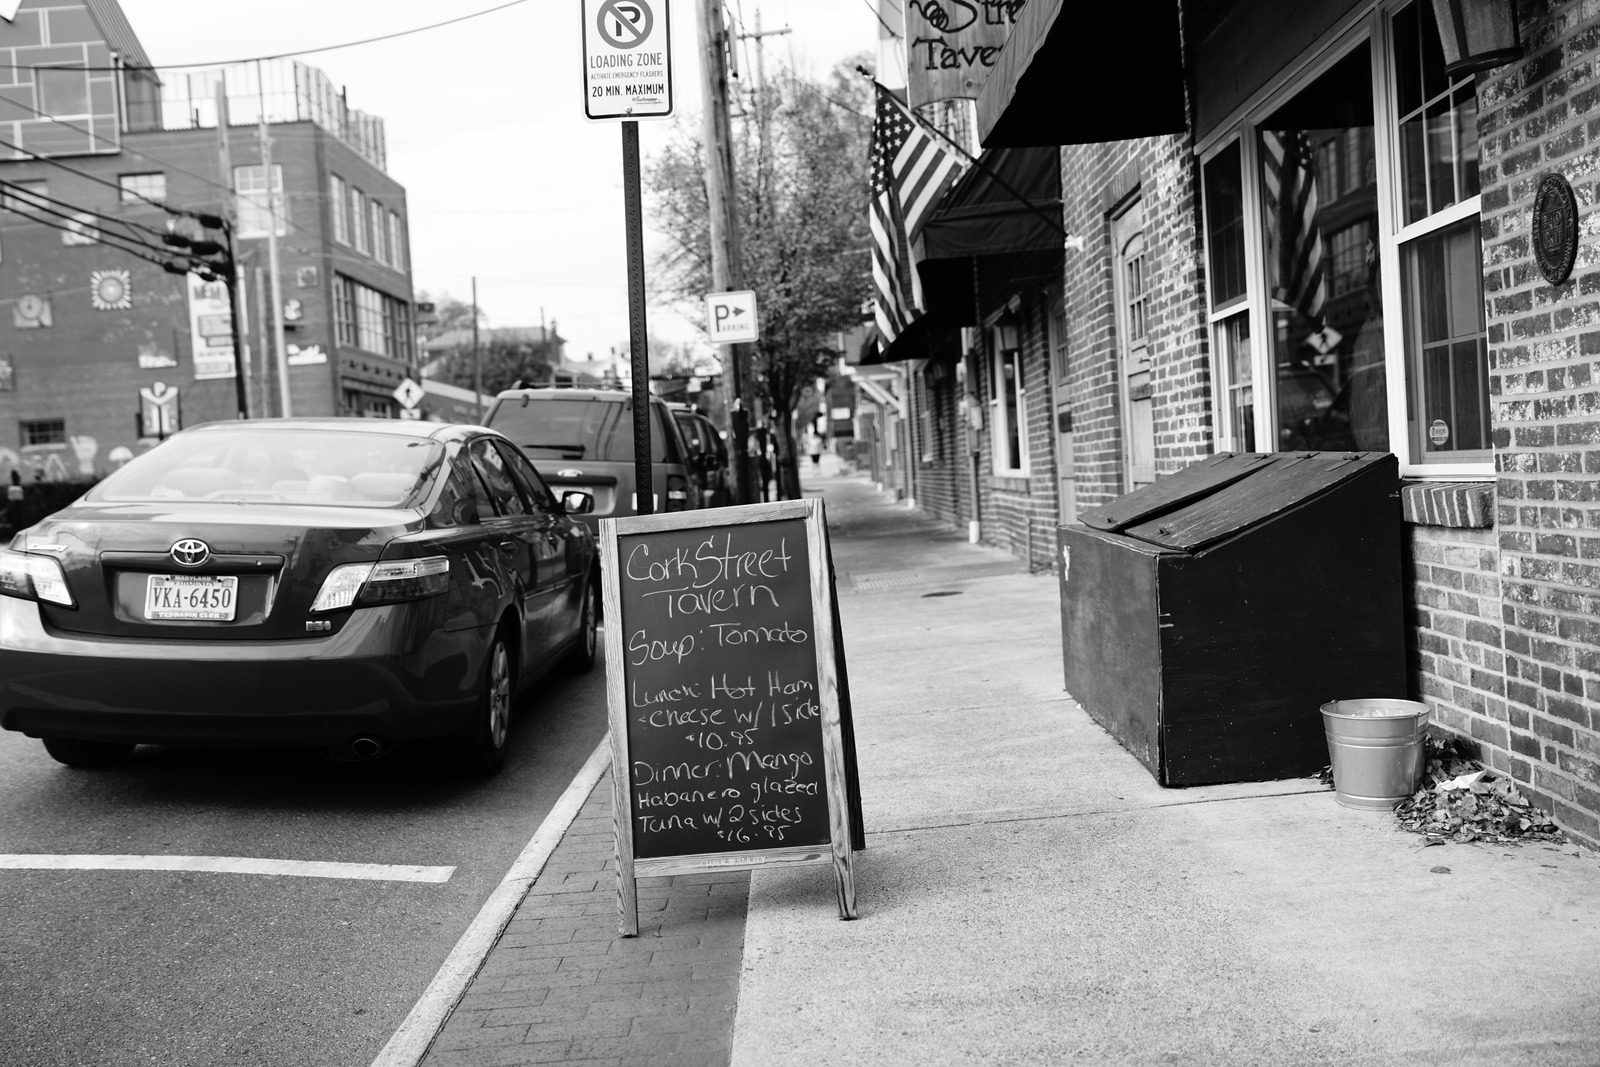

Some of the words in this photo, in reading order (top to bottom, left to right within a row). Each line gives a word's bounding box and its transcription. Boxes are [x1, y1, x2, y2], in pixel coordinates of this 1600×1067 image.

[590, 54, 633, 68] LOADING
[637, 52, 663, 66] ZONE
[912, 36, 1004, 70] Tave
[590, 72, 611, 80] ACTIVATE
[612, 71, 638, 79] EMERGENCY
[640, 70, 663, 78] FLASHERS
[592, 86, 603, 97] 20
[606, 85, 623, 96] MIN.
[625, 83, 665, 95] MAXIMUM
[627, 543, 698, 581] Cork
[692, 533, 792, 588] Street
[153, 587, 232, 608] VKA-6450
[642, 583, 780, 618] Tavern
[709, 621, 807, 646] Tomato
[711, 673, 756, 699] Hot
[768, 670, 813, 696] Ham
[726, 750, 813, 780] Mango
[638, 788, 741, 809] Habanero
[750, 776, 818, 803] glazed
[638, 815, 698, 833] Tuna
[728, 804, 745, 823] 2
[748, 804, 802, 825] sides
